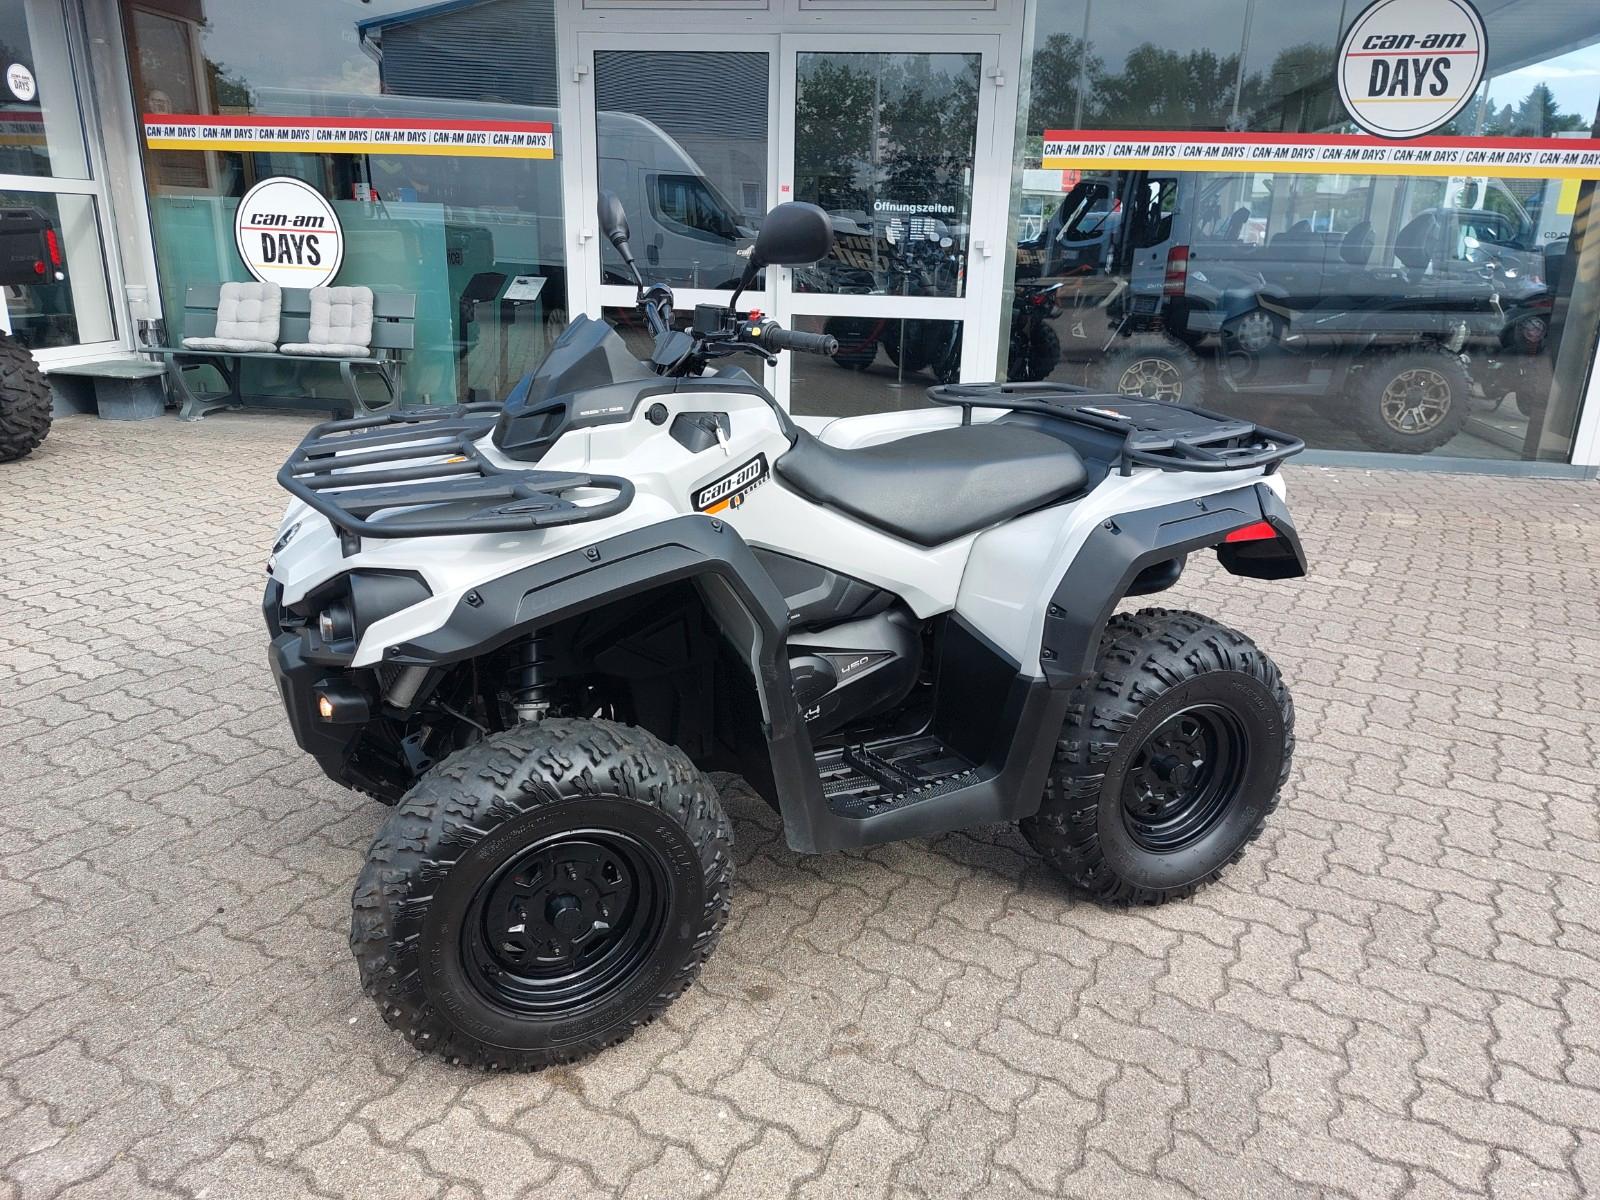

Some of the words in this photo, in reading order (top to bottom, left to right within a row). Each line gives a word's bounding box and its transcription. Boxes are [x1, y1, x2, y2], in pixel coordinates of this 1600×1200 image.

[1362, 33, 1467, 50] can-am
[1367, 57, 1451, 97] DAYS
[147, 126, 176, 137] CAN-AM
[178, 127, 196, 138] DAYS
[203, 128, 232, 139] CAN-AM
[234, 128, 253, 139] DAYS
[259, 129, 289, 140] CAN-AM
[291, 129, 310, 140] DAYS
[316, 130, 347, 141] CAN-AM
[349, 131, 368, 142] DAYS
[374, 131, 405, 142] CAN-AM
[407, 132, 426, 143] DAYS
[433, 133, 464, 144] CAN-AM
[466, 133, 486, 144] DAYS
[493, 134, 524, 145] CAN-AM
[526, 135, 546, 146] DAYS
[1044, 144, 1080, 155] CAN-AM
[1082, 144, 1105, 156] DAYS
[1113, 145, 1150, 156] CAN-AM
[1152, 146, 1176, 157] DAYS
[1183, 146, 1220, 158] CAN-AM
[1222, 147, 1245, 158] DAYS
[1252, 147, 1290, 159] CAN-AM
[1291, 148, 1315, 159] DAYS
[1322, 149, 1360, 160] CAN-AM
[1361, 149, 1385, 161] DAYS
[1393, 150, 1432, 161] CAN-AM
[1433, 151, 1458, 162] DAYS
[1465, 151, 1505, 163] CAN-AM
[1506, 152, 1532, 163] DAYS
[1540, 152, 1579, 164] CAN-AM
[873, 199, 955, 214] Öffnungszeiten
[250, 213, 325, 228] can-am
[261, 232, 321, 266] DAYS
[700, 462, 759, 505] can-am
[841, 656, 869, 673] 450
